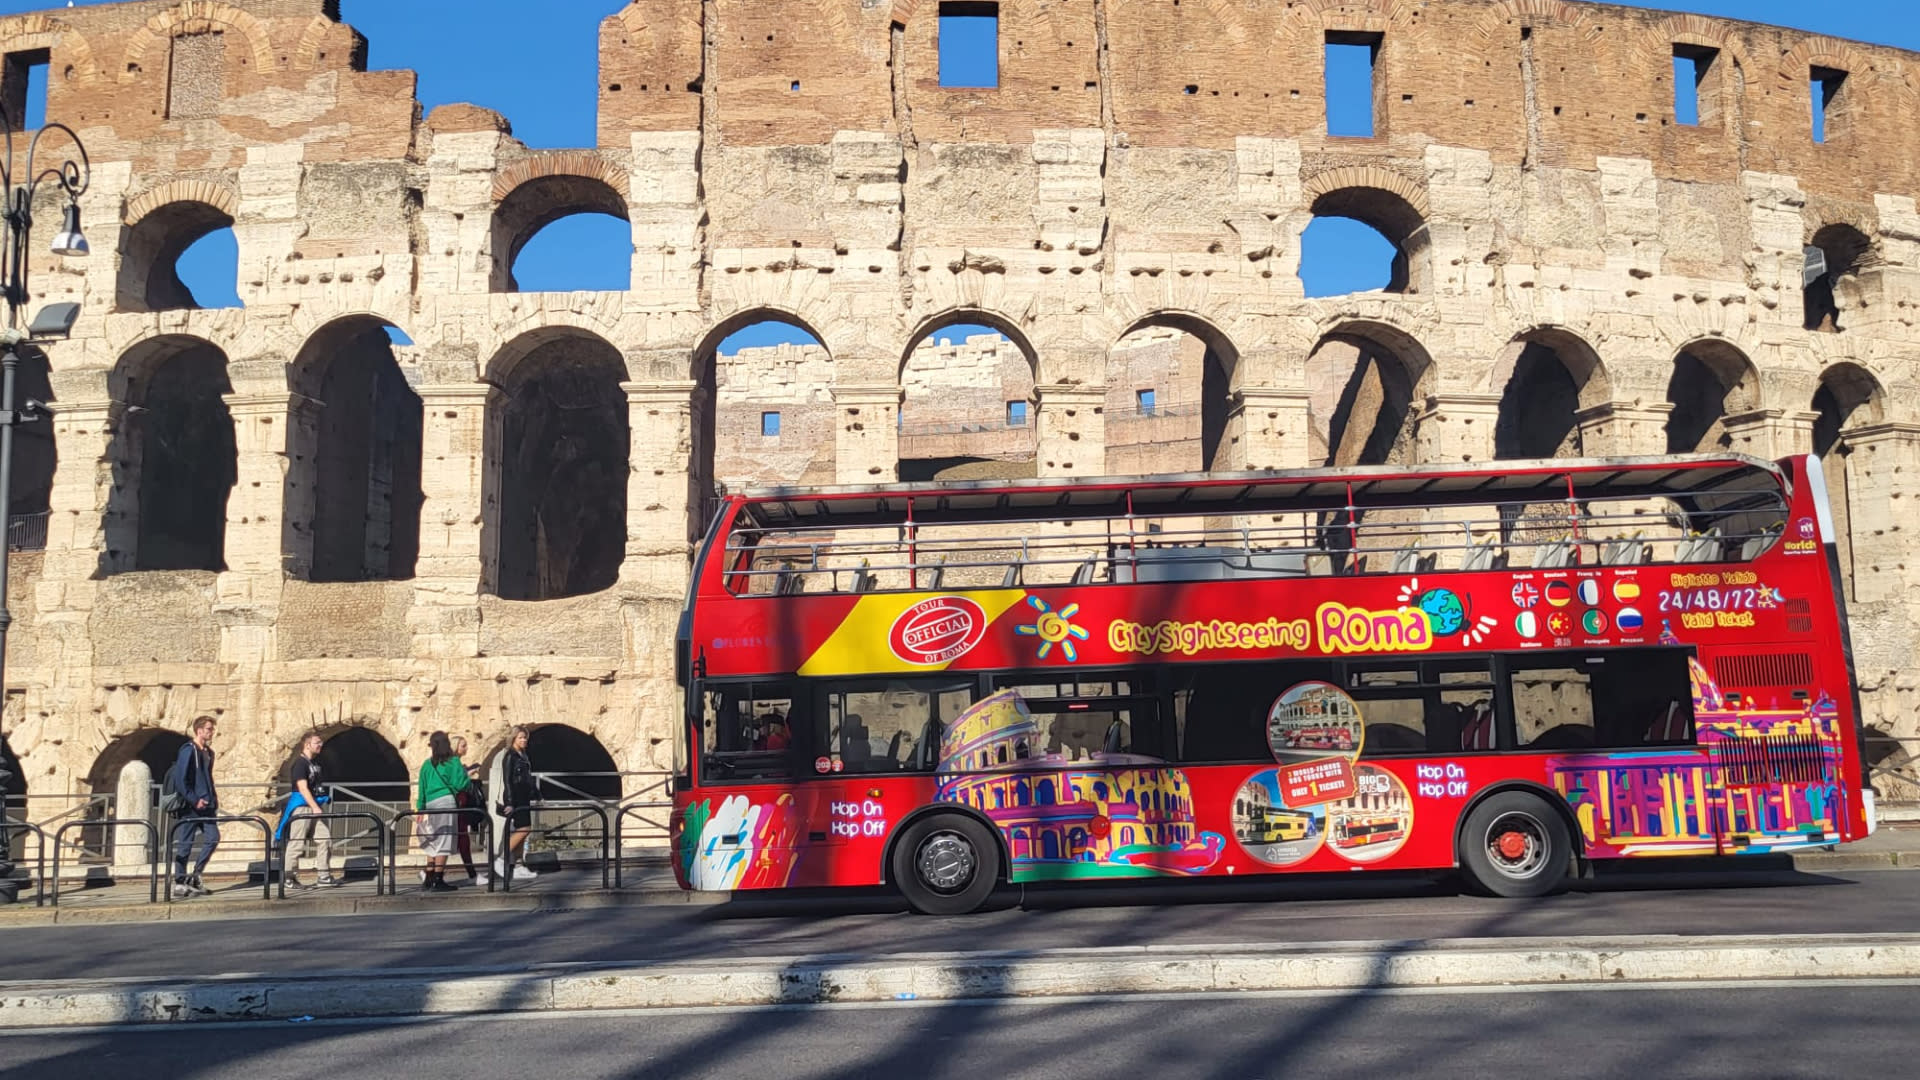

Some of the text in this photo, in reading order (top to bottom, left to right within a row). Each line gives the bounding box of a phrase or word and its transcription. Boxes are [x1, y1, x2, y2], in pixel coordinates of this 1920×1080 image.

[914, 599, 944, 615] TOUR
[1659, 587, 1755, 612] 24/48/72
[1315, 602, 1433, 653] Roma
[1682, 611, 1755, 628] Valid Ticket
[905, 616, 969, 645] OFFICIAL
[925, 641, 970, 663] OF ROMA
[1359, 775, 1376, 785] BIG
[1417, 763, 1465, 779] Hop On
[1309, 780, 1319, 798] 1
[1359, 784, 1377, 793] BUS
[1419, 781, 1468, 798] Hop Off
[831, 800, 883, 818] Hop On
[831, 820, 886, 838] Hop Off
